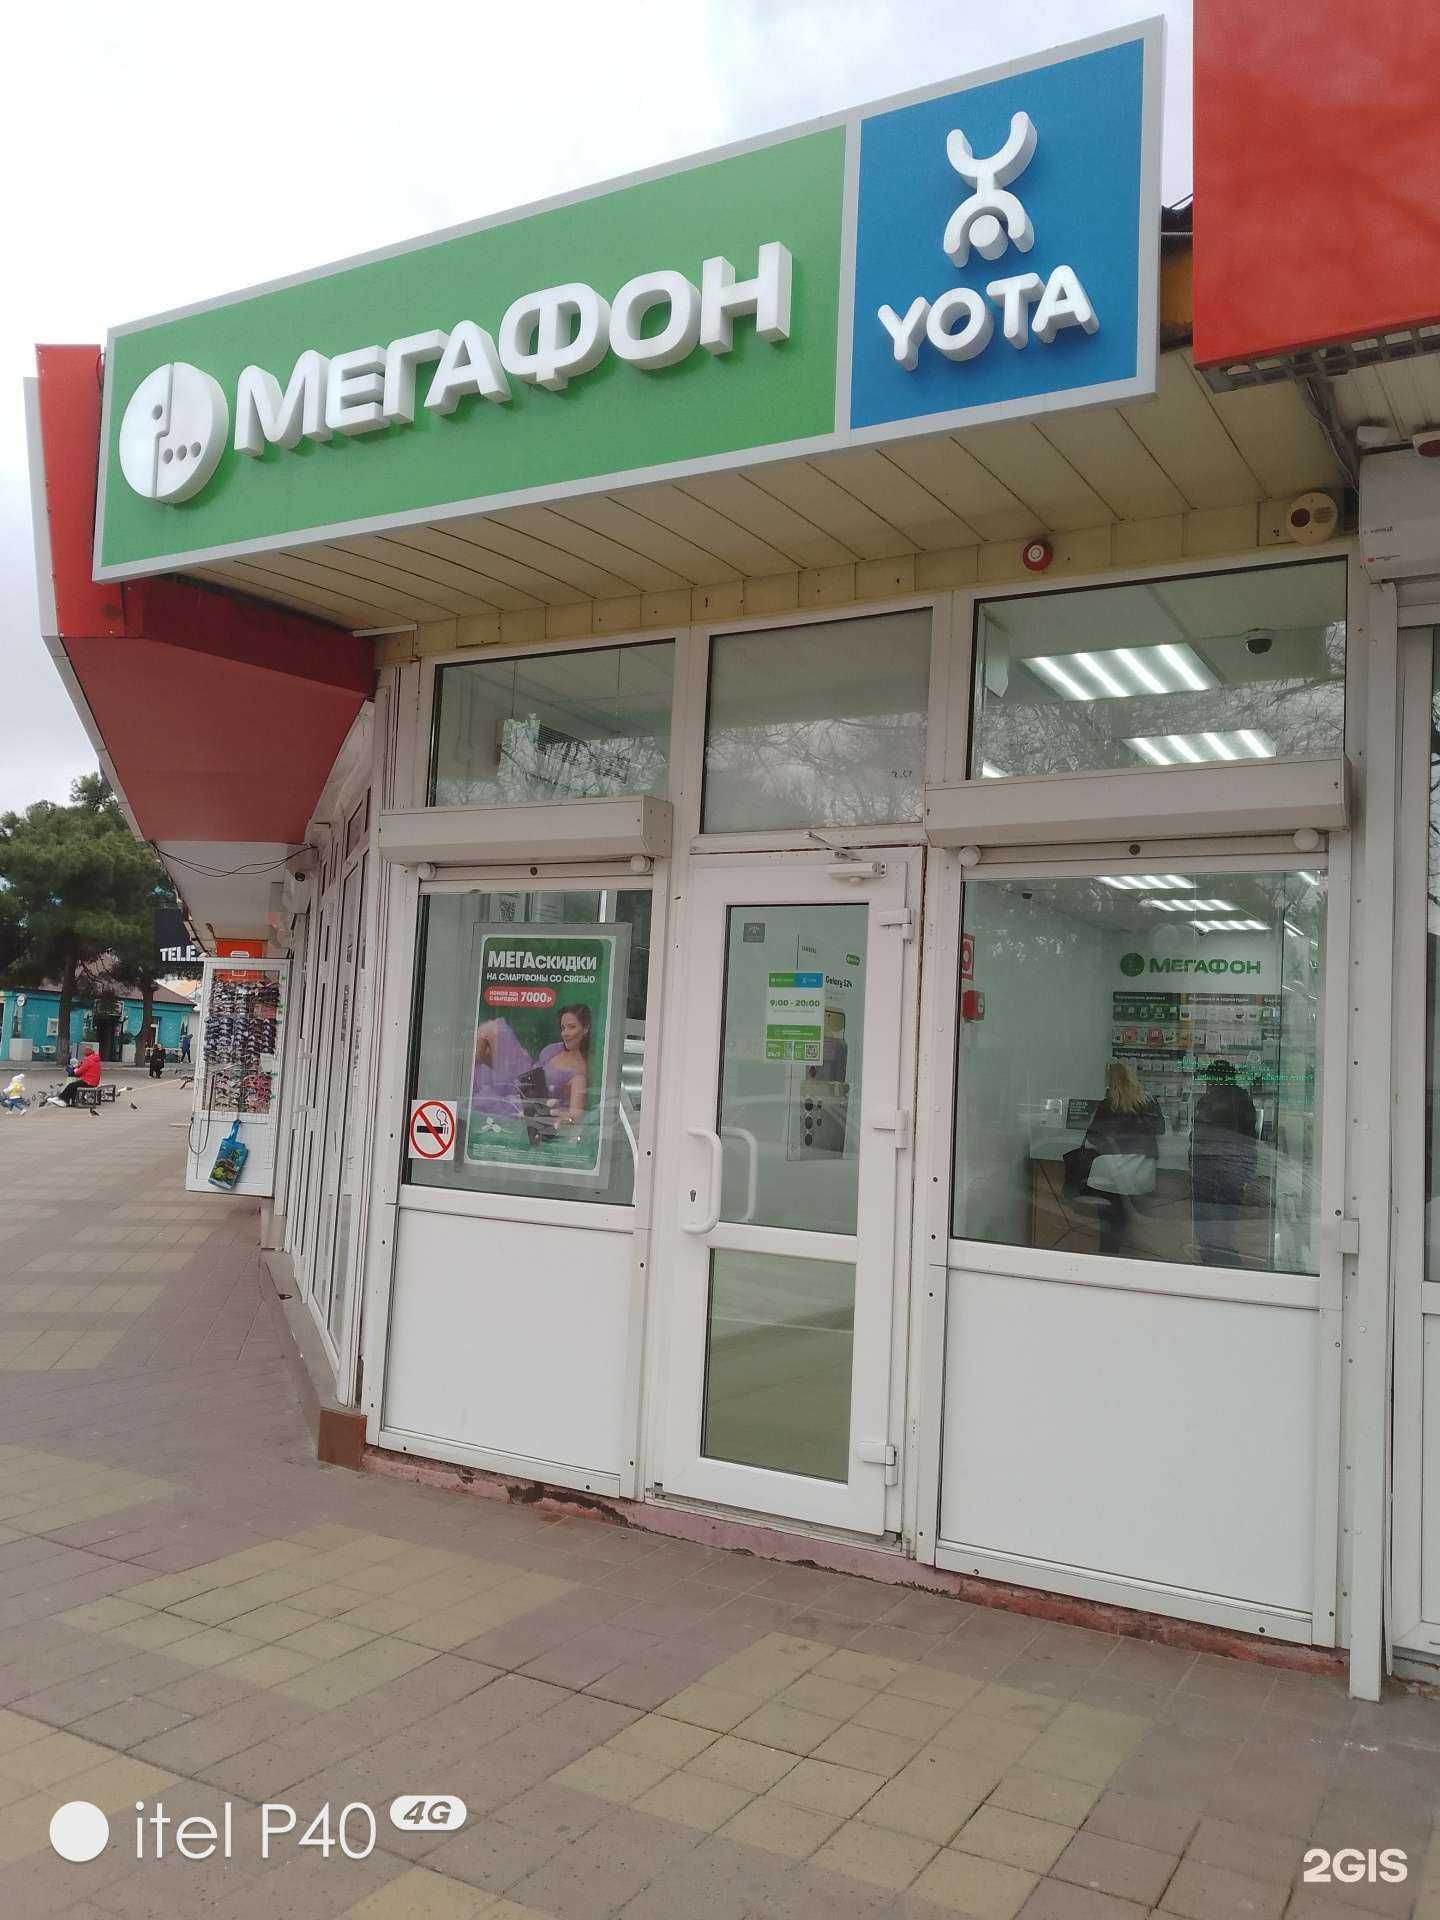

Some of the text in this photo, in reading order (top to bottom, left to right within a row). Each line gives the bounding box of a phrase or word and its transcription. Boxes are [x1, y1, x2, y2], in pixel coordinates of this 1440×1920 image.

[878, 264, 1100, 372] YOTA
[234, 240, 793, 459] МЕГАФОН
[1149, 957, 1262, 975] МЕГАФОН
[486, 972, 596, 984] НА СМАРТФОНЫ СО СВЯЗЬЮ
[769, 999, 789, 1008] 9:00
[795, 999, 820, 1008] 20:00
